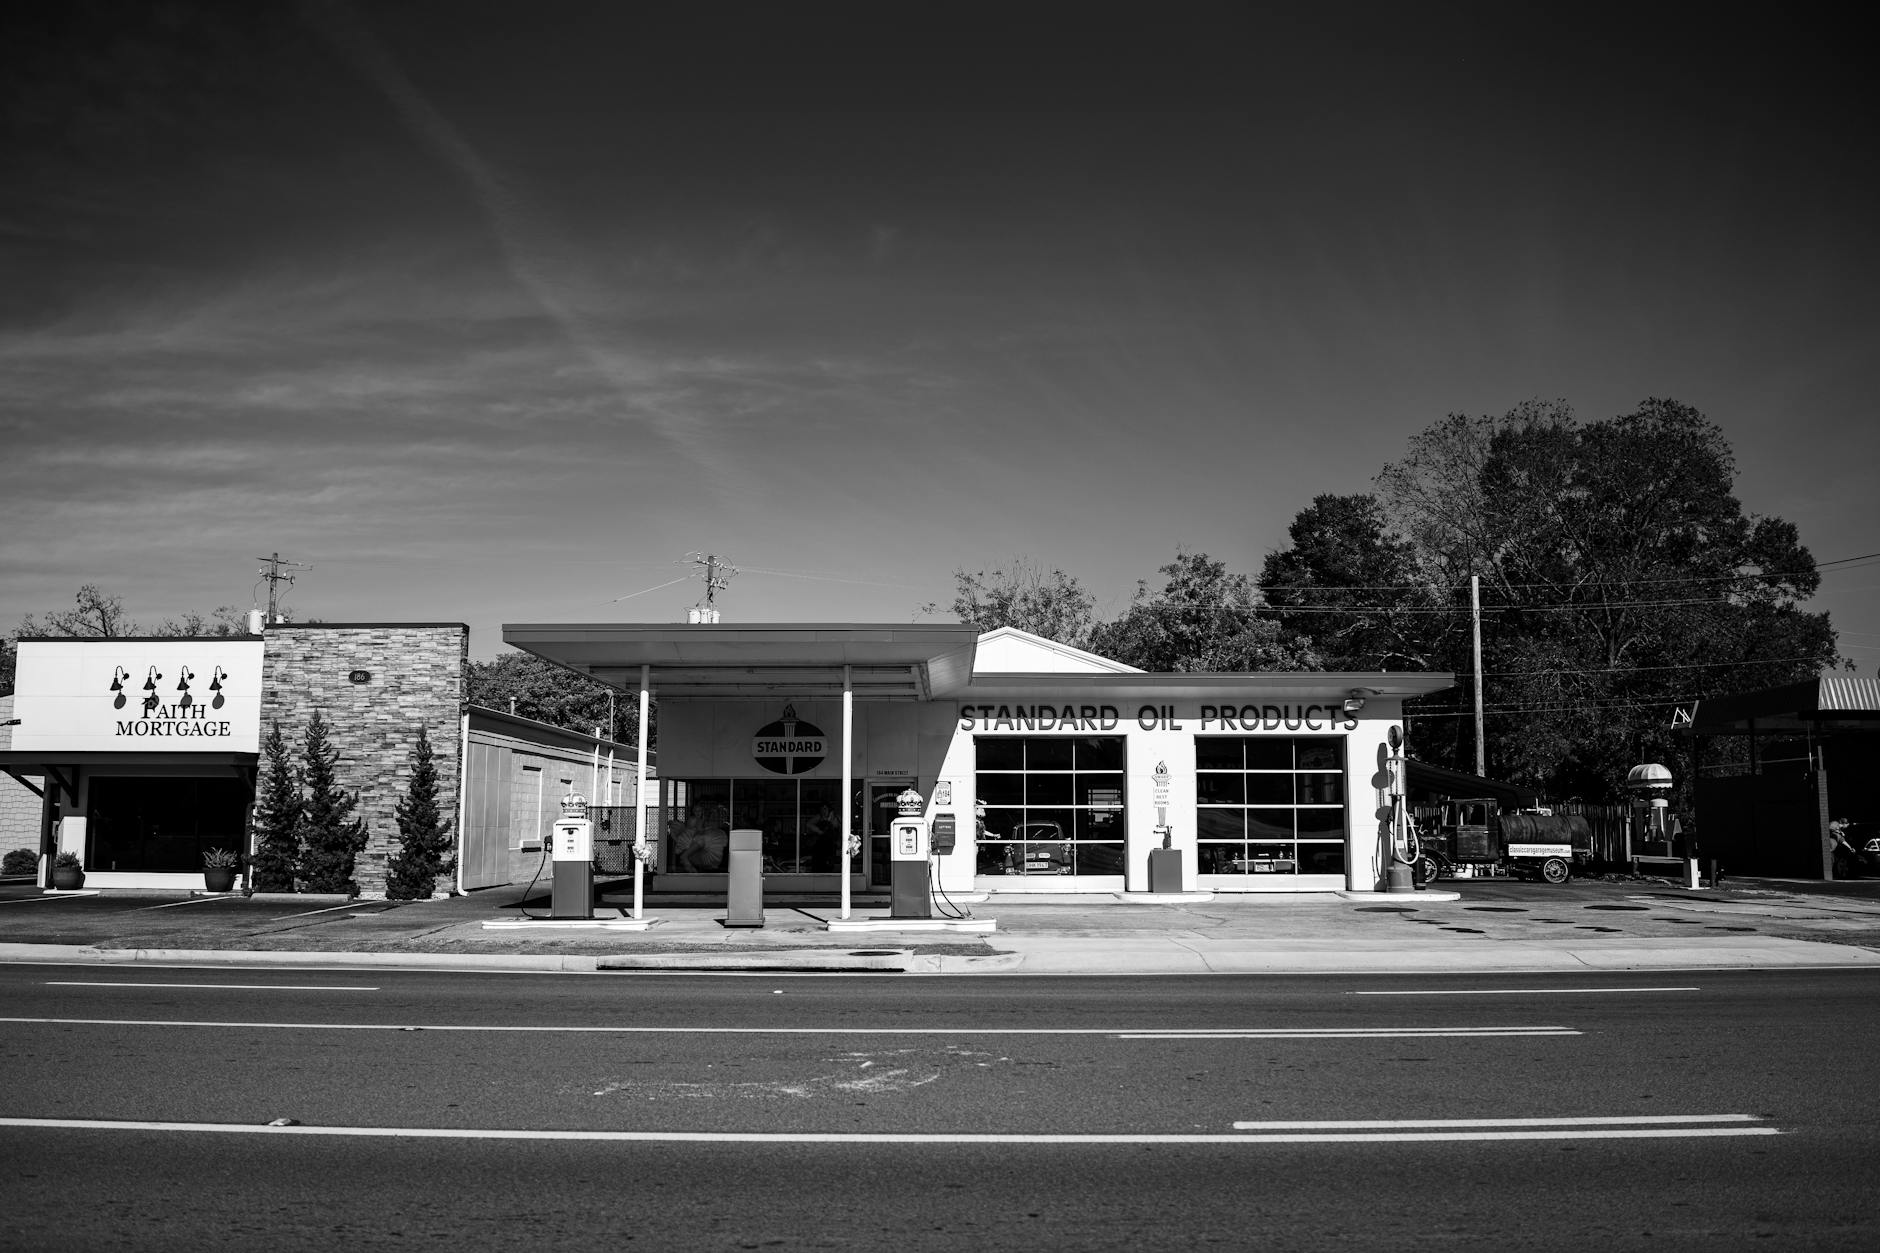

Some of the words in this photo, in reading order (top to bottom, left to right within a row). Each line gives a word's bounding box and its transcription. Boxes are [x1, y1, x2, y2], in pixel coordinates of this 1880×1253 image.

[354, 672, 366, 681] 186
[141, 697, 207, 719] FAITH
[960, 704, 1120, 731] STANDARD
[1137, 704, 1183, 731] OIL
[1200, 704, 1359, 731] PRODUCTS
[115, 720, 231, 737] MORTGAGE
[757, 741, 823, 753] STANDARD
